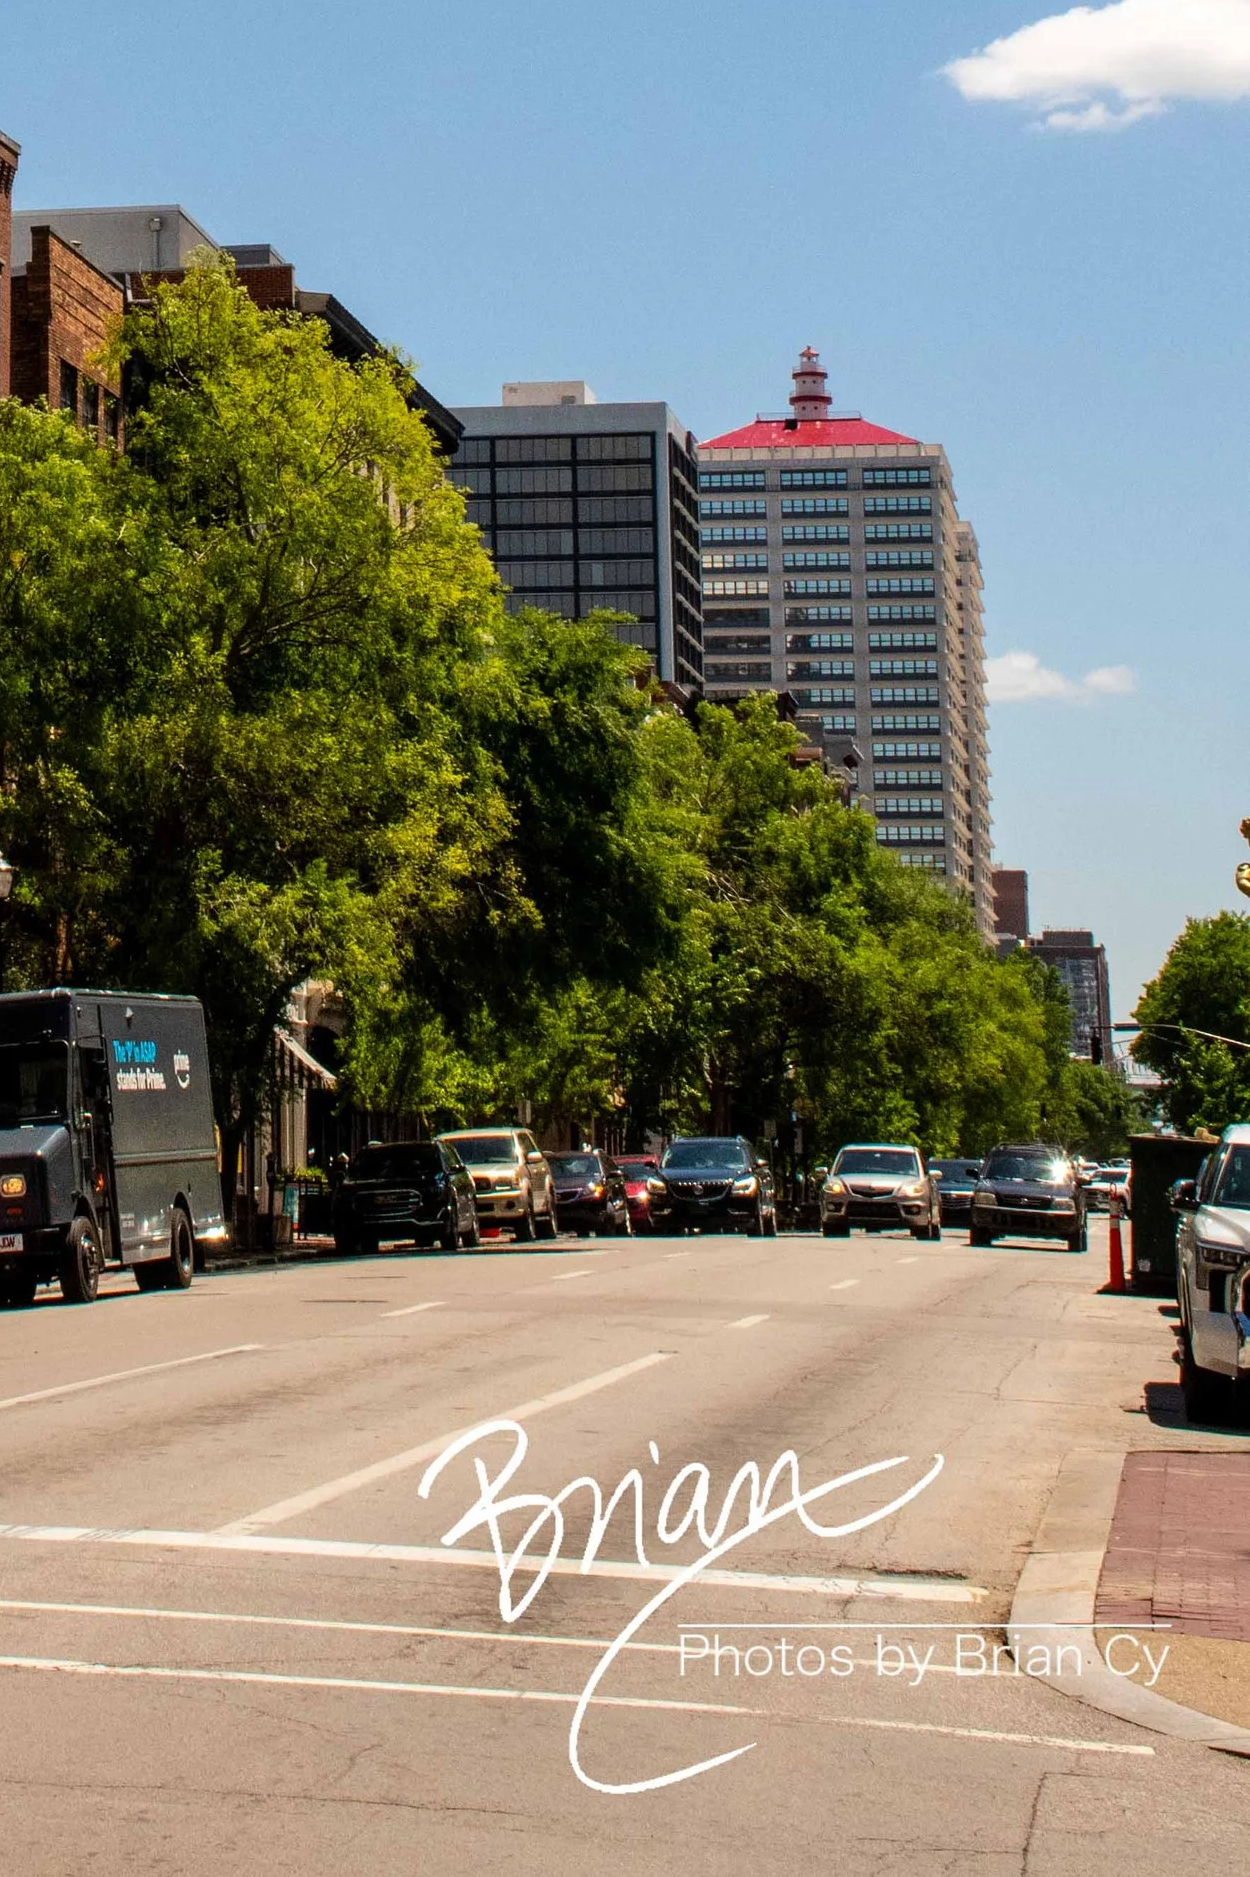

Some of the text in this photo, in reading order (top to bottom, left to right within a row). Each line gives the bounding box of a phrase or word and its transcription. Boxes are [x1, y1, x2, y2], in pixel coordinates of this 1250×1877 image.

[113, 1040, 126, 1062] The
[116, 1067, 137, 1090] stands
[137, 1067, 146, 1090] for
